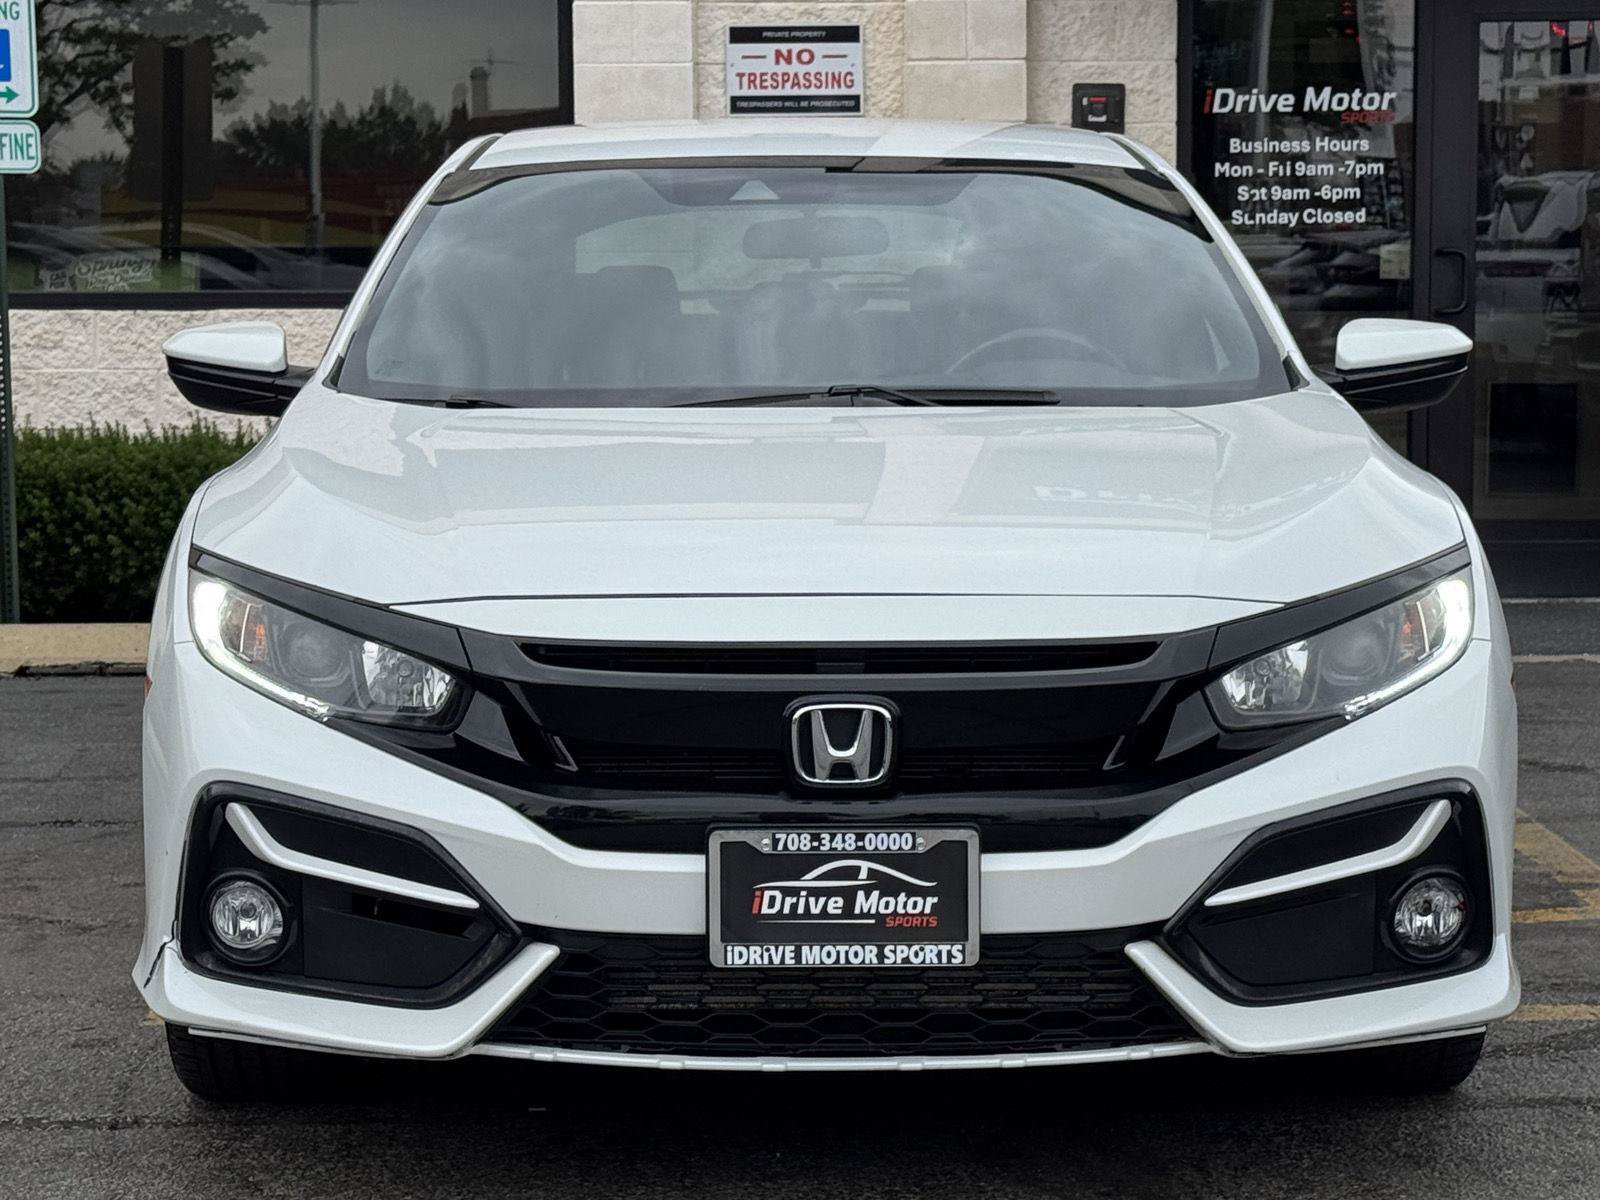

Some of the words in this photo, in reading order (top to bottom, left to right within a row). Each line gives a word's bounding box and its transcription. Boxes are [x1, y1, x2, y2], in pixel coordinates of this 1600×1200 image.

[774, 48, 815, 66] NO
[735, 71, 855, 90] TRESPASSING
[1203, 88, 1296, 113] iDrive
[1303, 86, 1397, 112] Motor
[0, 132, 35, 160] FINE
[1229, 137, 1311, 154] Business
[1315, 137, 1370, 152] Hours
[1214, 162, 1254, 178] Mon
[1295, 161, 1334, 176] 9am
[1271, 186, 1310, 201] 9am
[1231, 209, 1299, 228] Sunday
[1302, 208, 1367, 224] Closed
[775, 833, 913, 851] 708-348-0000
[752, 890, 844, 914] iDrive
[854, 890, 938, 914] Motor
[885, 916, 938, 927] SPORTS
[726, 945, 796, 965] iDRIVE
[802, 945, 879, 965] MOTOR
[883, 945, 964, 965] SPORTS
